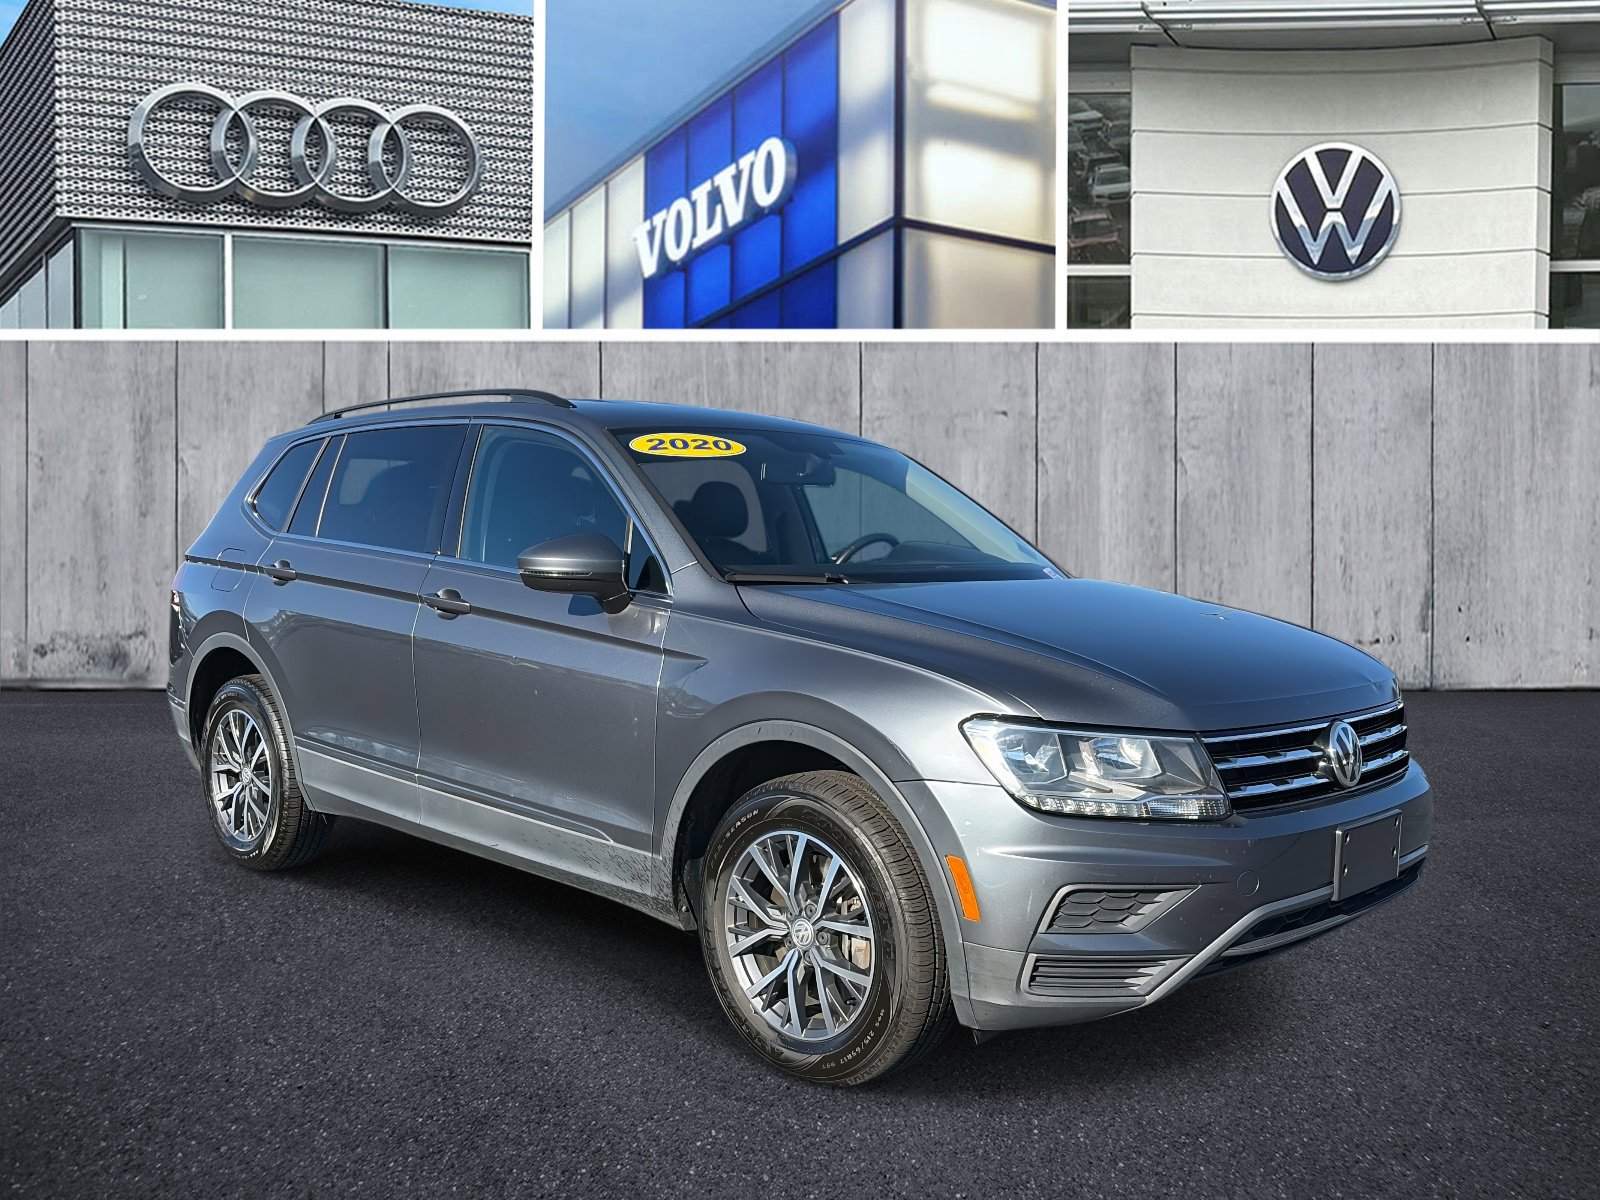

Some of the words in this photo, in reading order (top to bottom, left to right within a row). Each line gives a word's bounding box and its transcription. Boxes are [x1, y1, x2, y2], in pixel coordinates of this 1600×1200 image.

[632, 137, 787, 278] VOLVO
[1272, 144, 1399, 276] VW
[646, 438, 732, 451] 2020
[840, 1029, 875, 1065] 215/65R17
